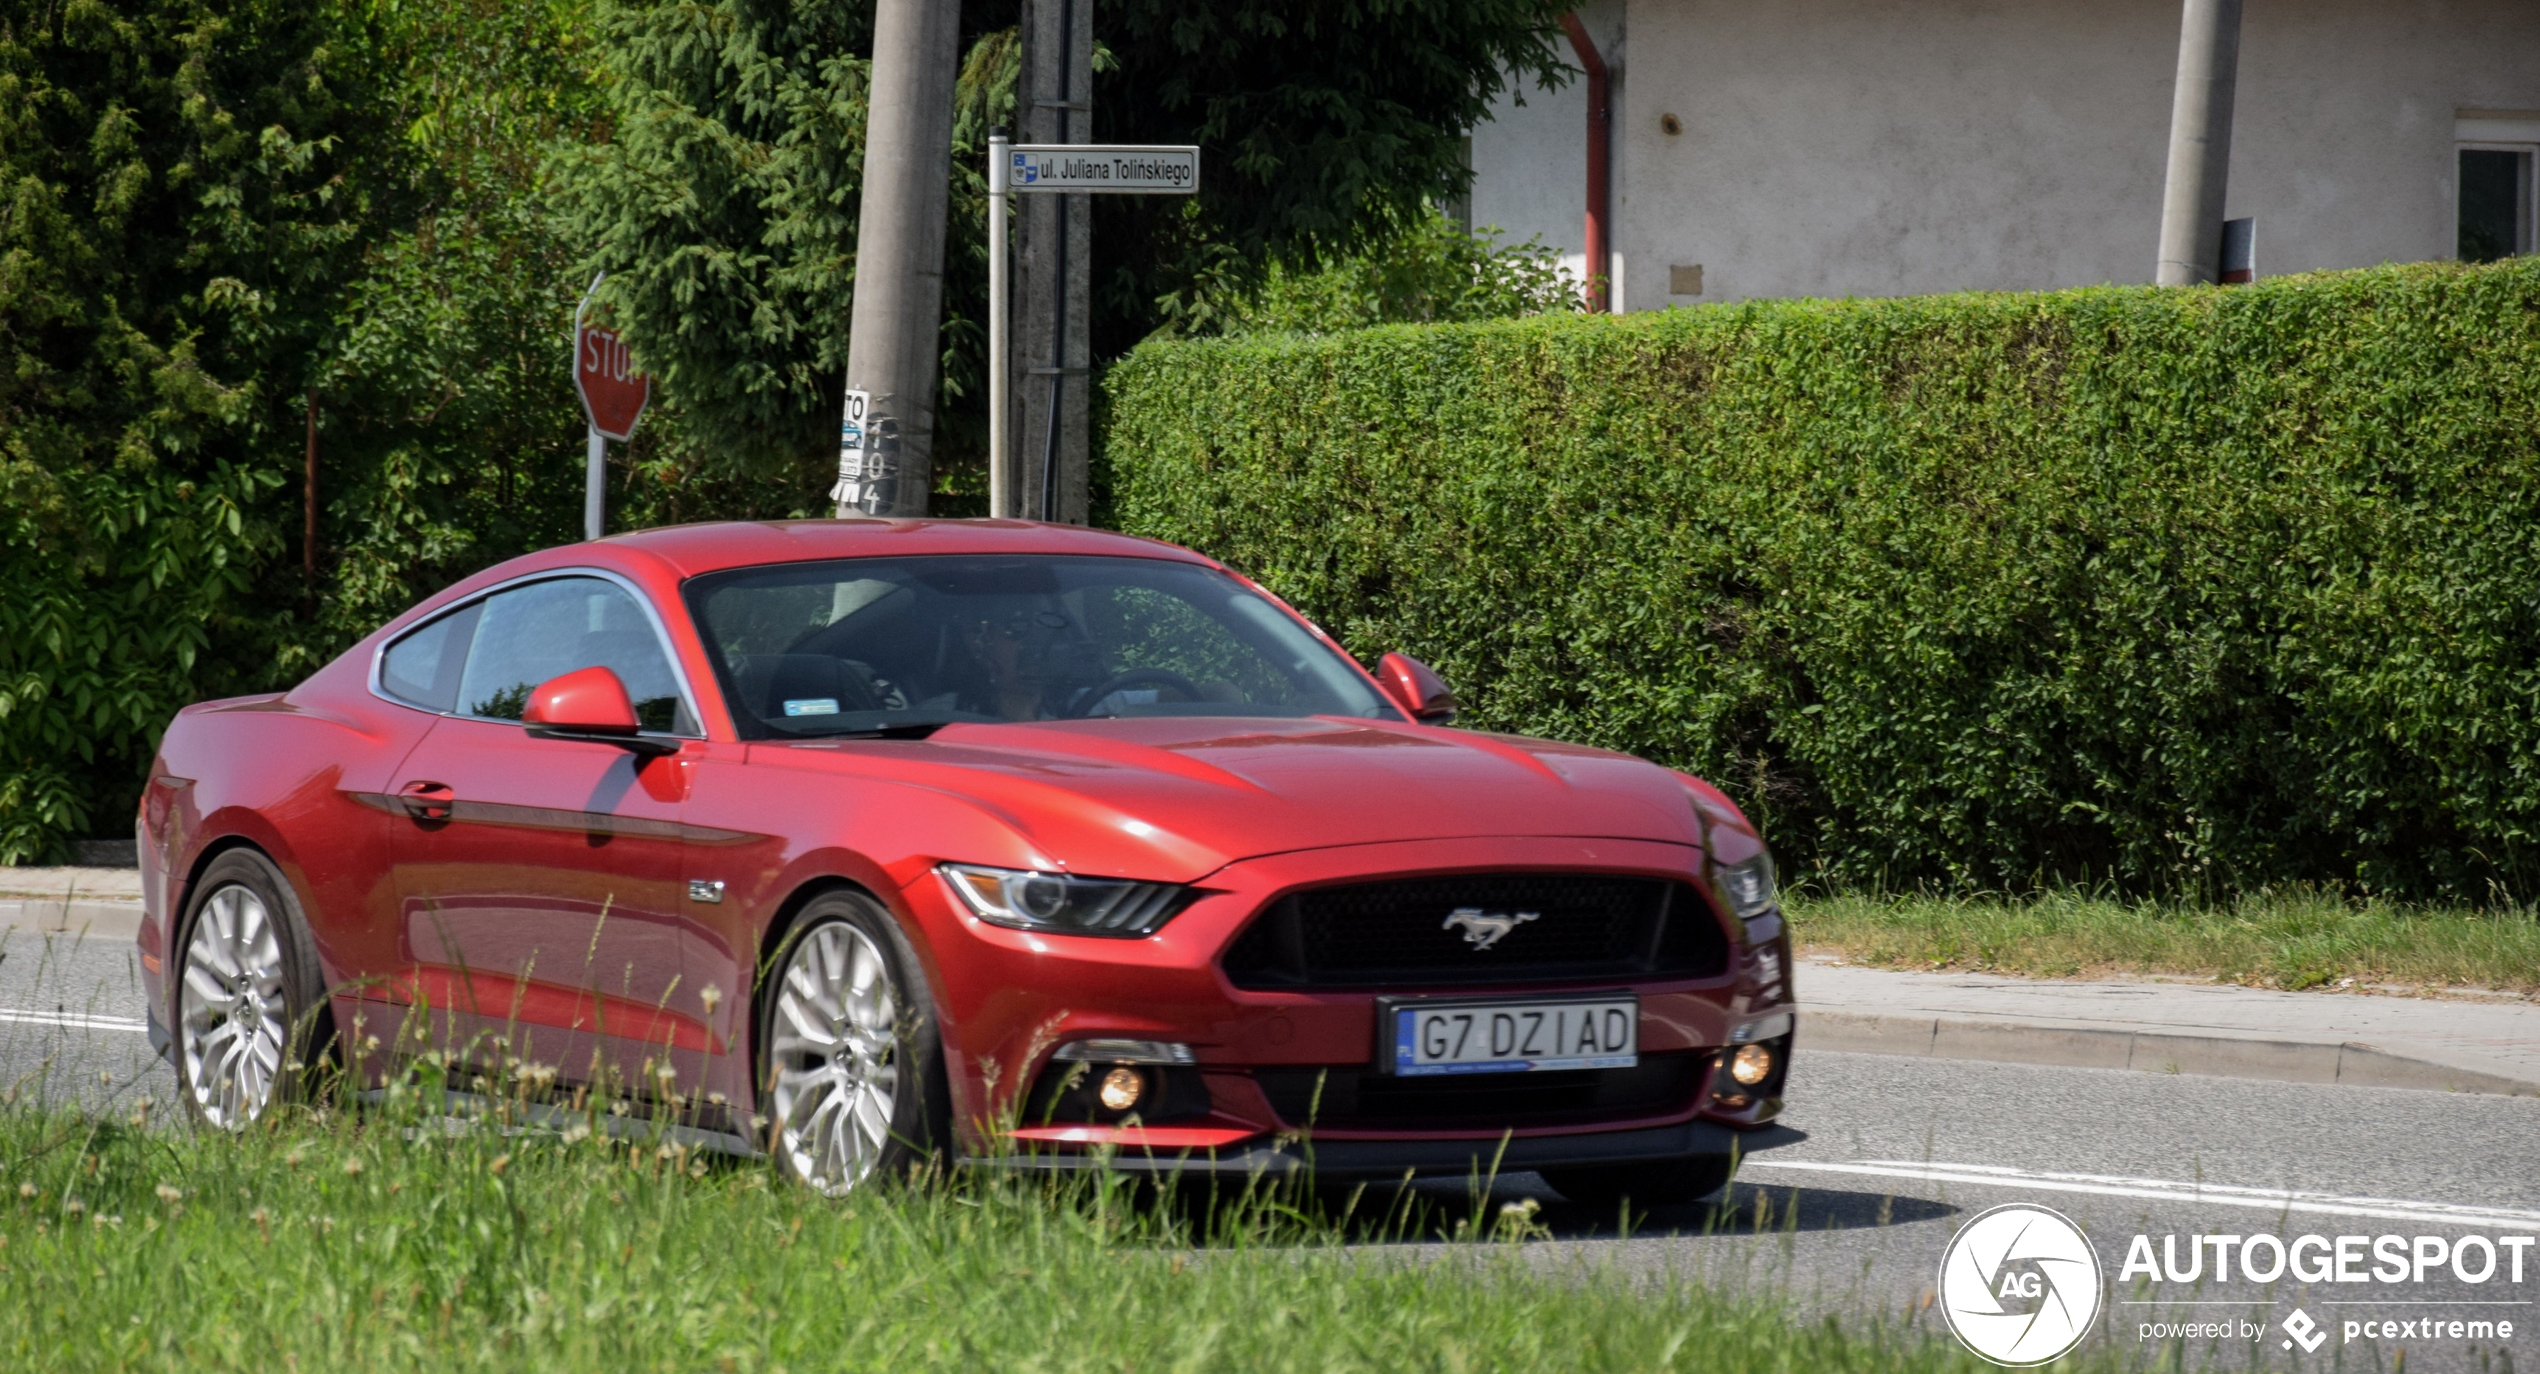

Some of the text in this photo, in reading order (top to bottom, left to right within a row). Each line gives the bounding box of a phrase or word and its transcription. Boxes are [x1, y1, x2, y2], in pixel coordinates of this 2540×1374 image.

[1041, 158, 1190, 185] ul. Juliana Tolińskiego
[1423, 1014, 1473, 1060] G7
